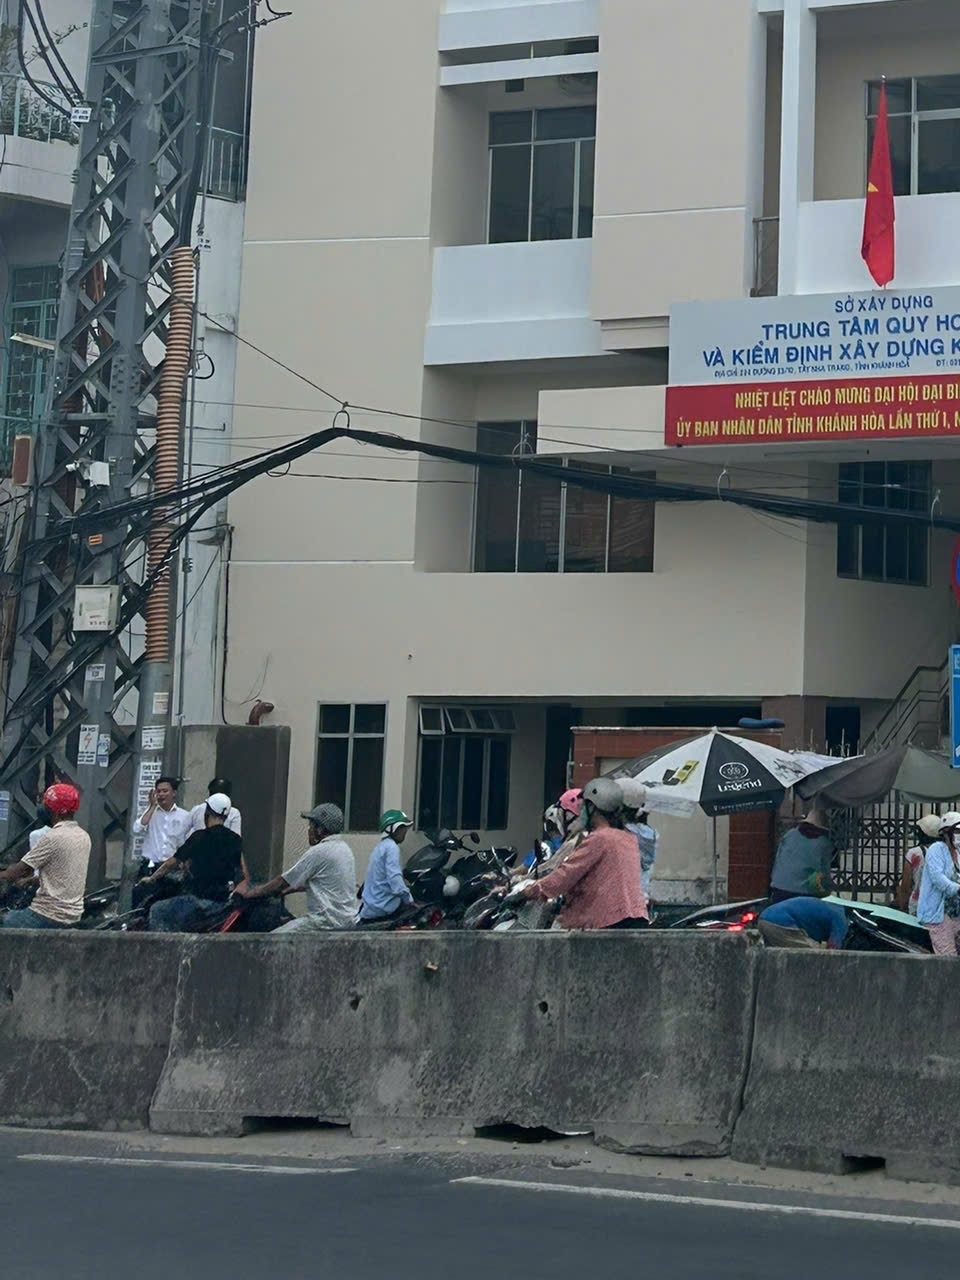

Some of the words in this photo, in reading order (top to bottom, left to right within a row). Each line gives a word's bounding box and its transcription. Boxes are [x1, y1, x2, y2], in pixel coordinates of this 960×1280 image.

[834, 295, 855, 313] SỞ
[858, 296, 886, 312] XÂY
[891, 295, 933, 313] DỰNG
[761, 321, 830, 340] TRUNG
[838, 316, 879, 336] TÂM
[886, 315, 928, 334] QUY
[703, 346, 725, 367] VÀ
[732, 340, 779, 366] KIỂM
[786, 344, 832, 365] ĐỊNH
[839, 339, 880, 360] XÂY
[887, 338, 944, 360] DỰNG
[735, 389, 769, 411] NHIỆT
[772, 387, 796, 410] LIỆT
[874, 385, 894, 406] ĐẠI
[898, 382, 918, 405] HỘI
[922, 383, 943, 404] ĐẠI
[676, 416, 691, 437] ỦY
[694, 420, 719, 438] BAN
[722, 416, 755, 435] NHÂN
[758, 415, 783, 435] DÂN
[786, 412, 813, 433] TỈNH
[816, 412, 857, 433] KHÁNH
[861, 410, 885, 430] HÒA
